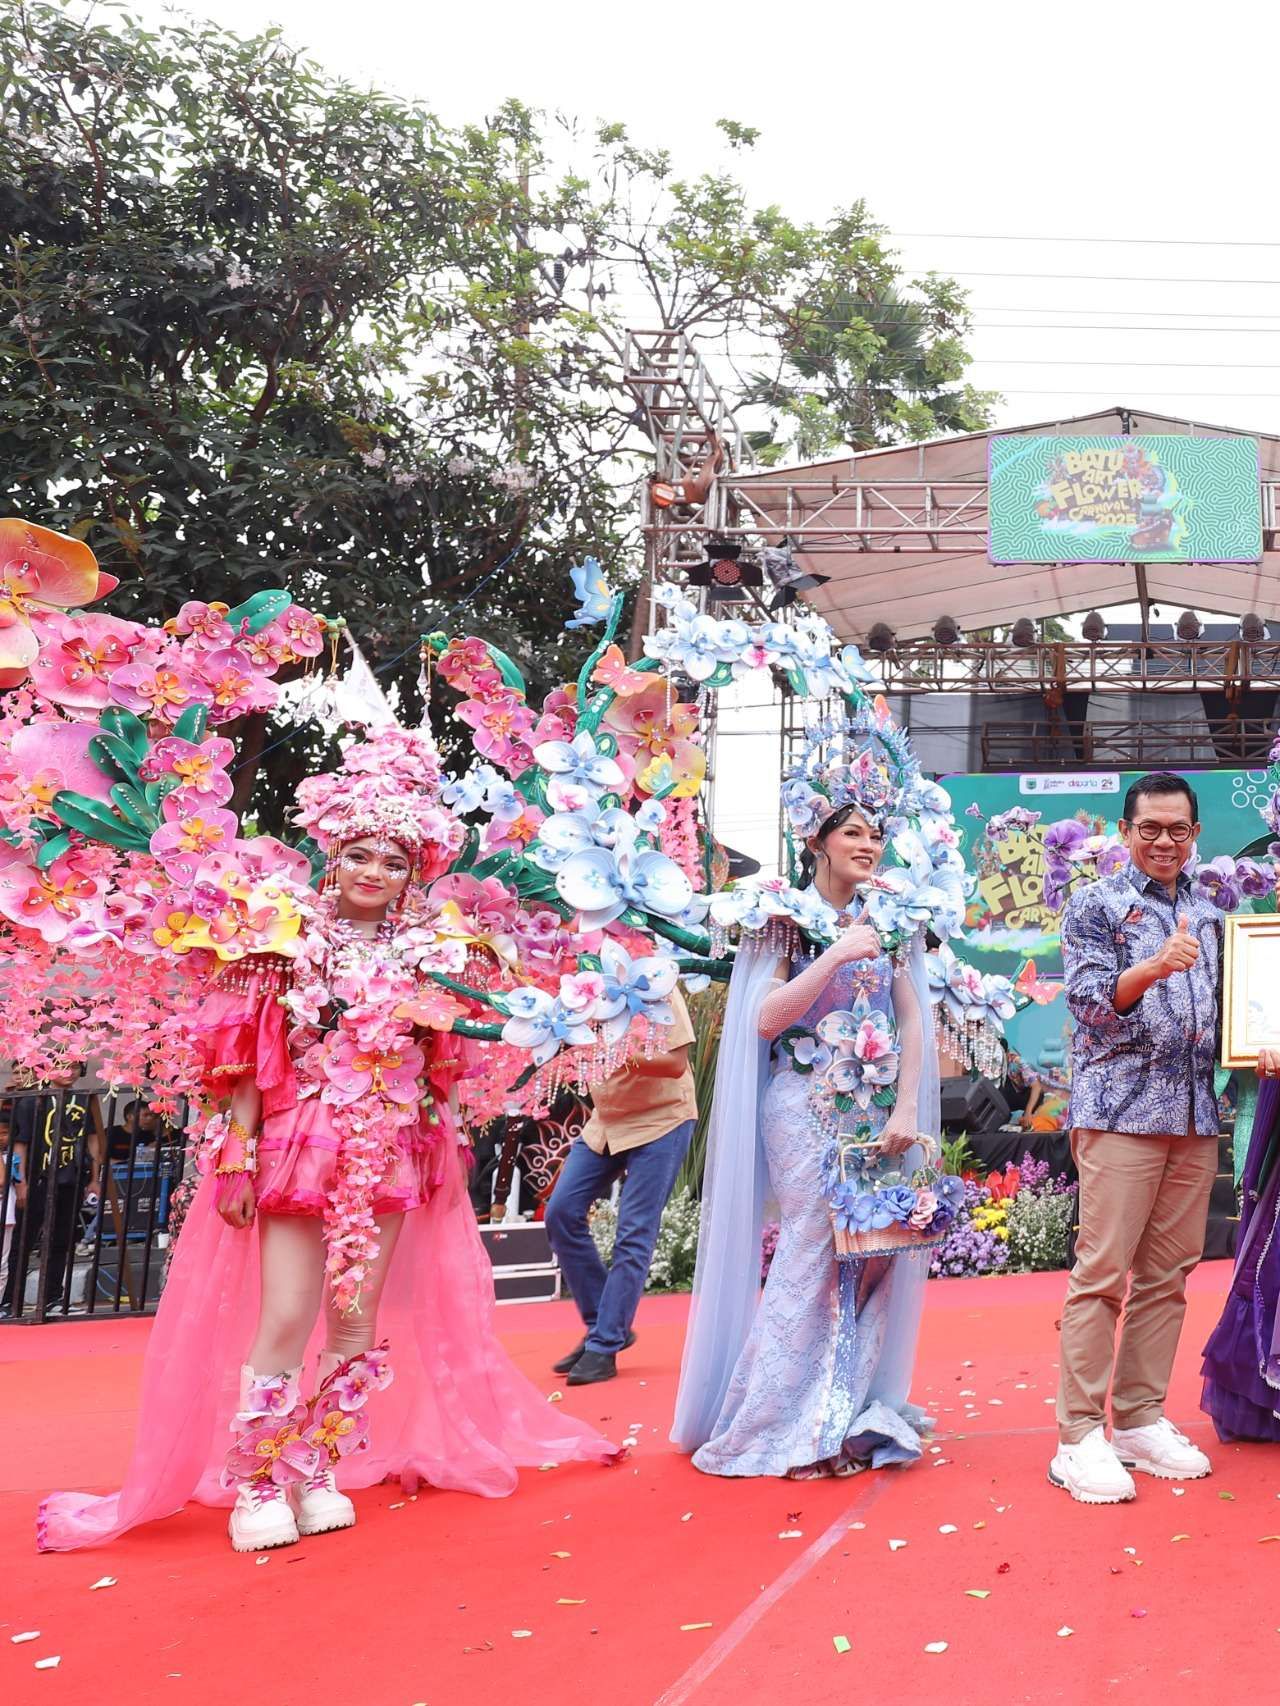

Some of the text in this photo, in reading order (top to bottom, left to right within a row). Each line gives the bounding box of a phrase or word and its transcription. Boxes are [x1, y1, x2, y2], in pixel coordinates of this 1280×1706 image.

[1064, 448, 1124, 475] BATU
[1082, 469, 1116, 486] ART
[1051, 478, 1144, 510] FLOWER
[1068, 499, 1130, 521] CARNIVAL
[1095, 512, 1138, 525] 2025
